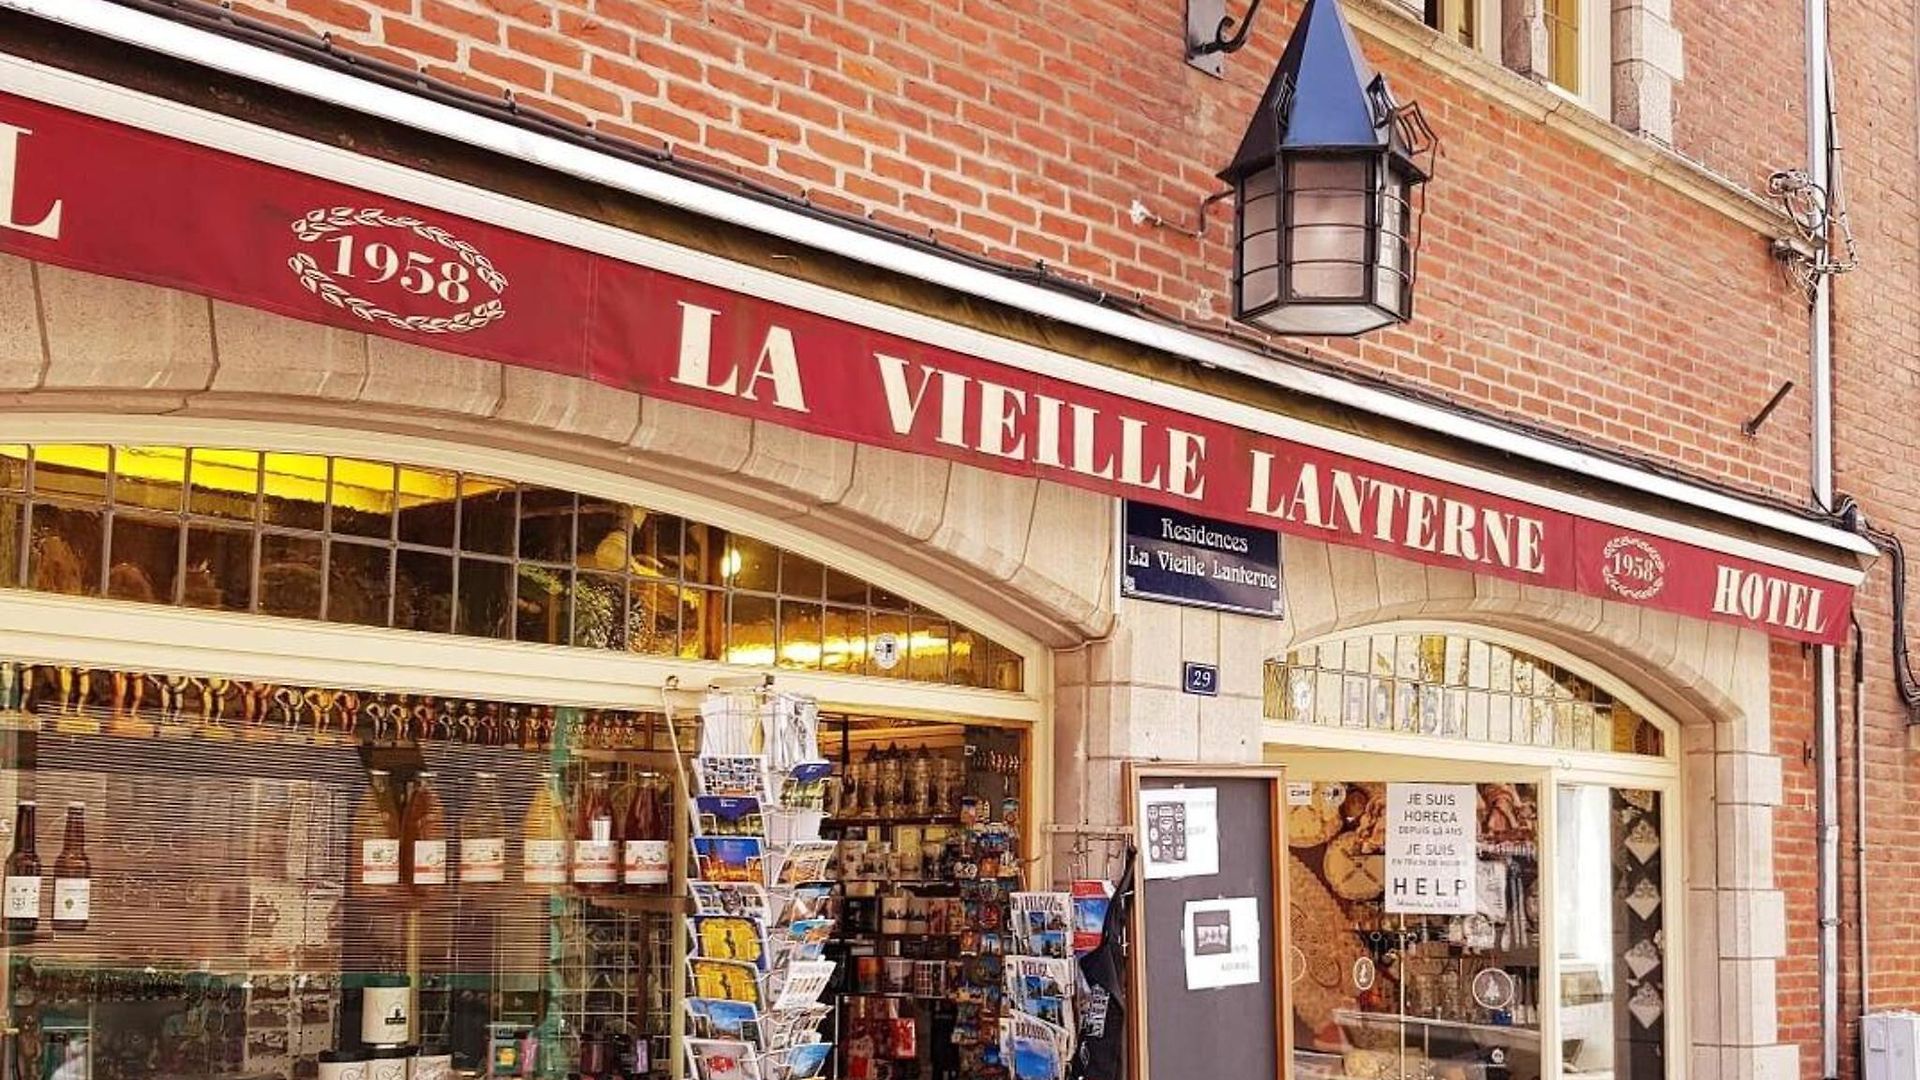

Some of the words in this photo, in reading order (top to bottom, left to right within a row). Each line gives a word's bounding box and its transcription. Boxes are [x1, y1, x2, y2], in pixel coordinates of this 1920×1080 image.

[326, 235, 470, 304] 1958
[670, 301, 809, 413] LA
[873, 353, 1207, 500] VIEILLE
[1247, 450, 1545, 574] LANTERNE
[1161, 518, 1248, 552] Residences
[1128, 545, 1149, 567] La
[1157, 550, 1205, 576] Vieille
[1213, 559, 1276, 589] Lanterne
[1612, 552, 1655, 581] 1958
[1712, 564, 1828, 634] HOTEL
[1193, 670, 1211, 687] 29
[1407, 793, 1421, 805] JE
[1426, 793, 1455, 806] SUIS
[1404, 810, 1458, 823] HORECA
[1406, 843, 1421, 856] JE
[1425, 843, 1455, 856] SUIS
[1393, 877, 1468, 896] HELP
